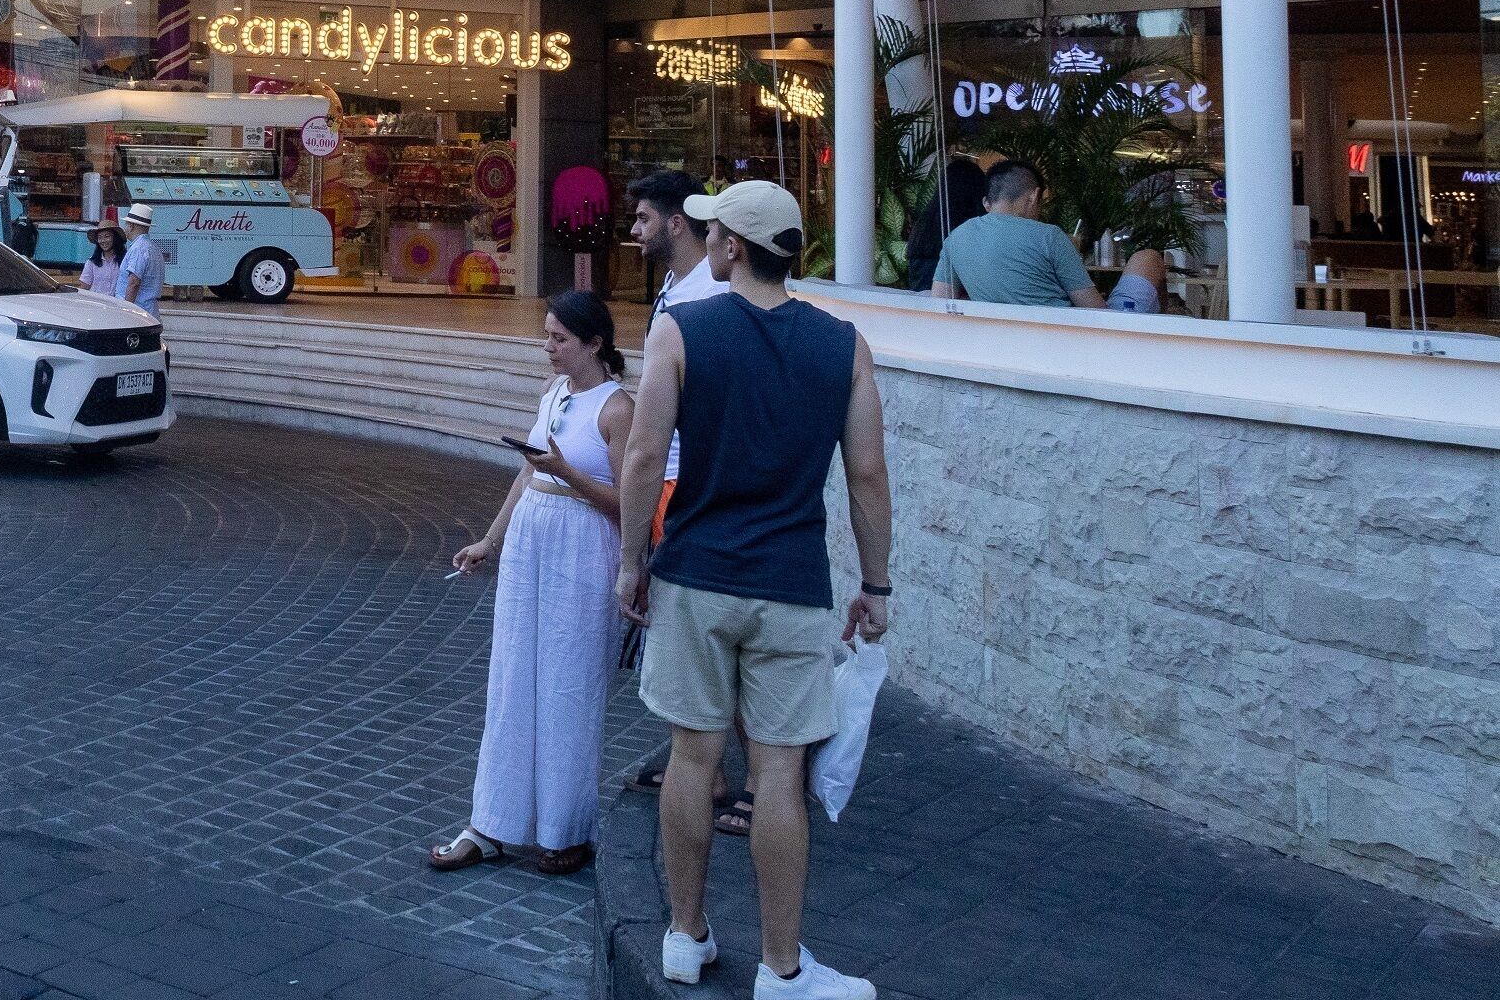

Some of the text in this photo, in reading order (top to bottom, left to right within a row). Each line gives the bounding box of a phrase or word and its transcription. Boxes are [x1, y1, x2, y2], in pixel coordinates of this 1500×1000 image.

[206, 6, 572, 75] candylicious
[305, 137, 336, 149] 40,000
[175, 207, 255, 232] Annette
